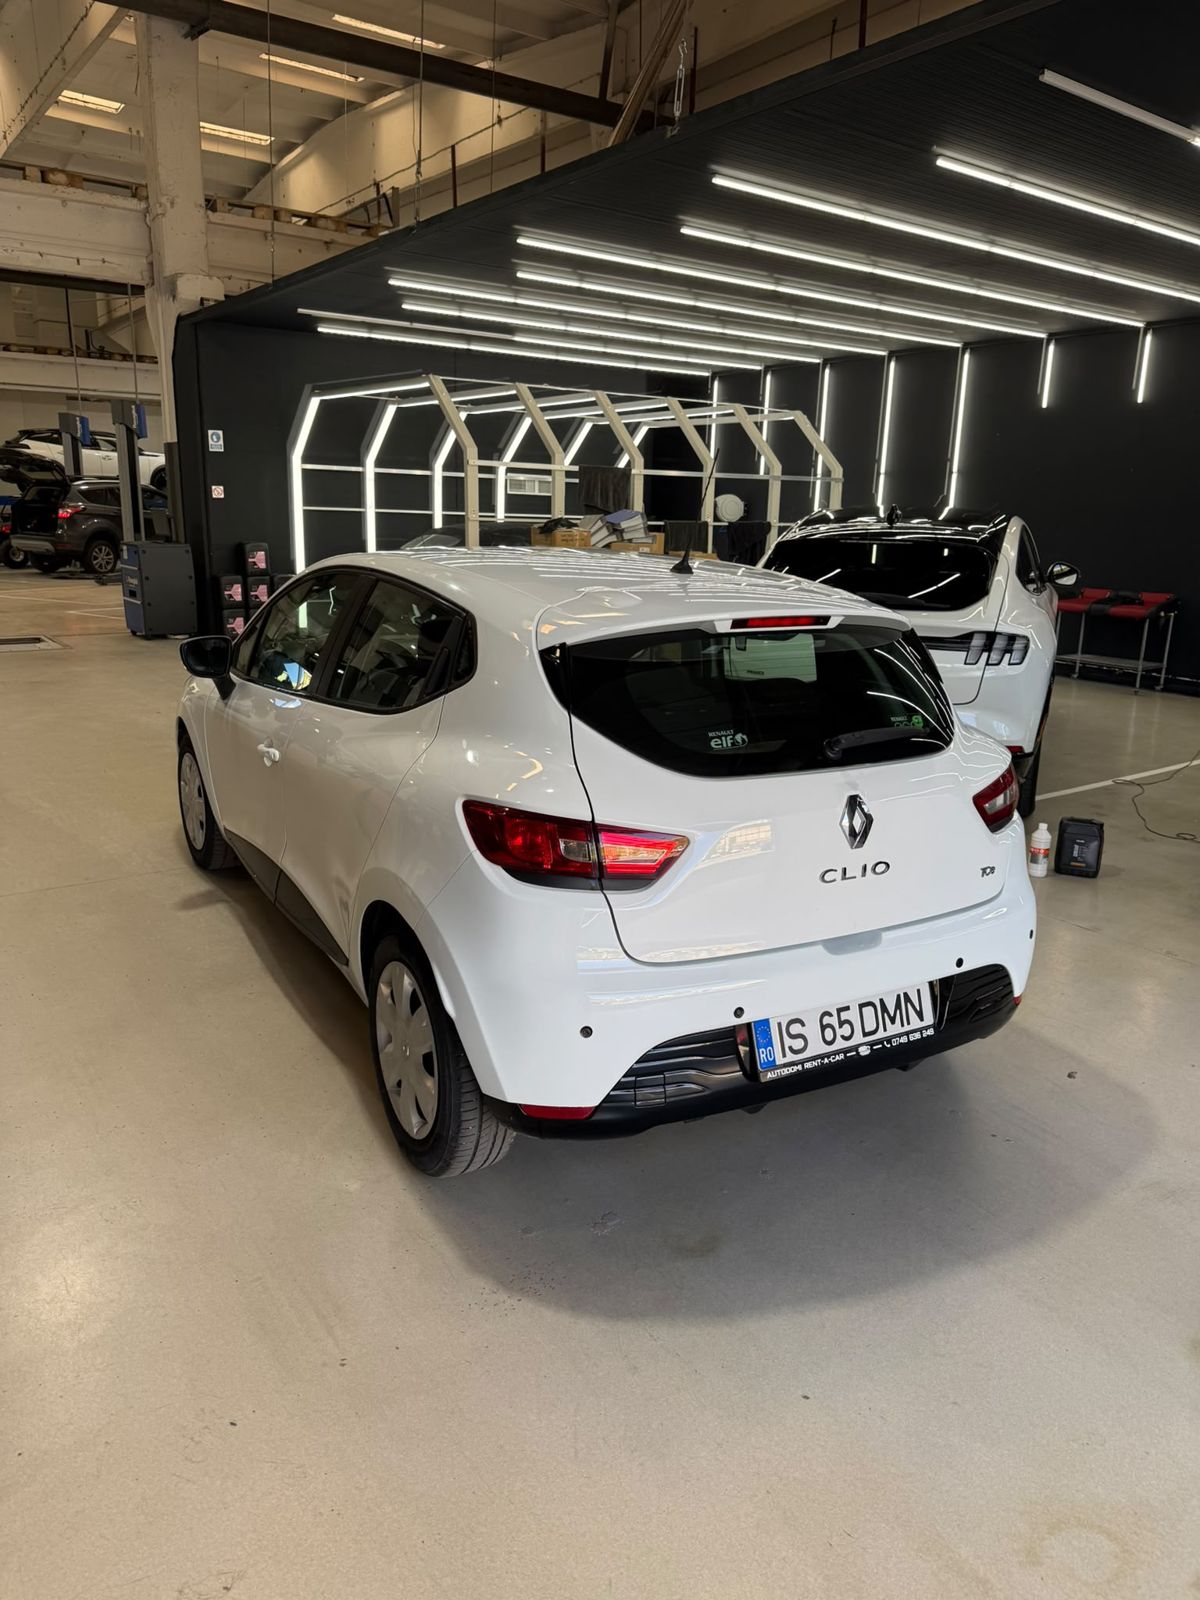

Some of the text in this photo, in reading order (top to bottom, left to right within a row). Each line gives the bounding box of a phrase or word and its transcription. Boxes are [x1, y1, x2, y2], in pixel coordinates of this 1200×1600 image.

[710, 735, 734, 748] elf
[819, 861, 891, 884] CLIO
[777, 988, 925, 1059] IS 65 DMN
[760, 1046, 775, 1064] RO
[767, 1064, 803, 1079] AUTODOMI
[804, 1053, 845, 1069] RENT-A-CAR
